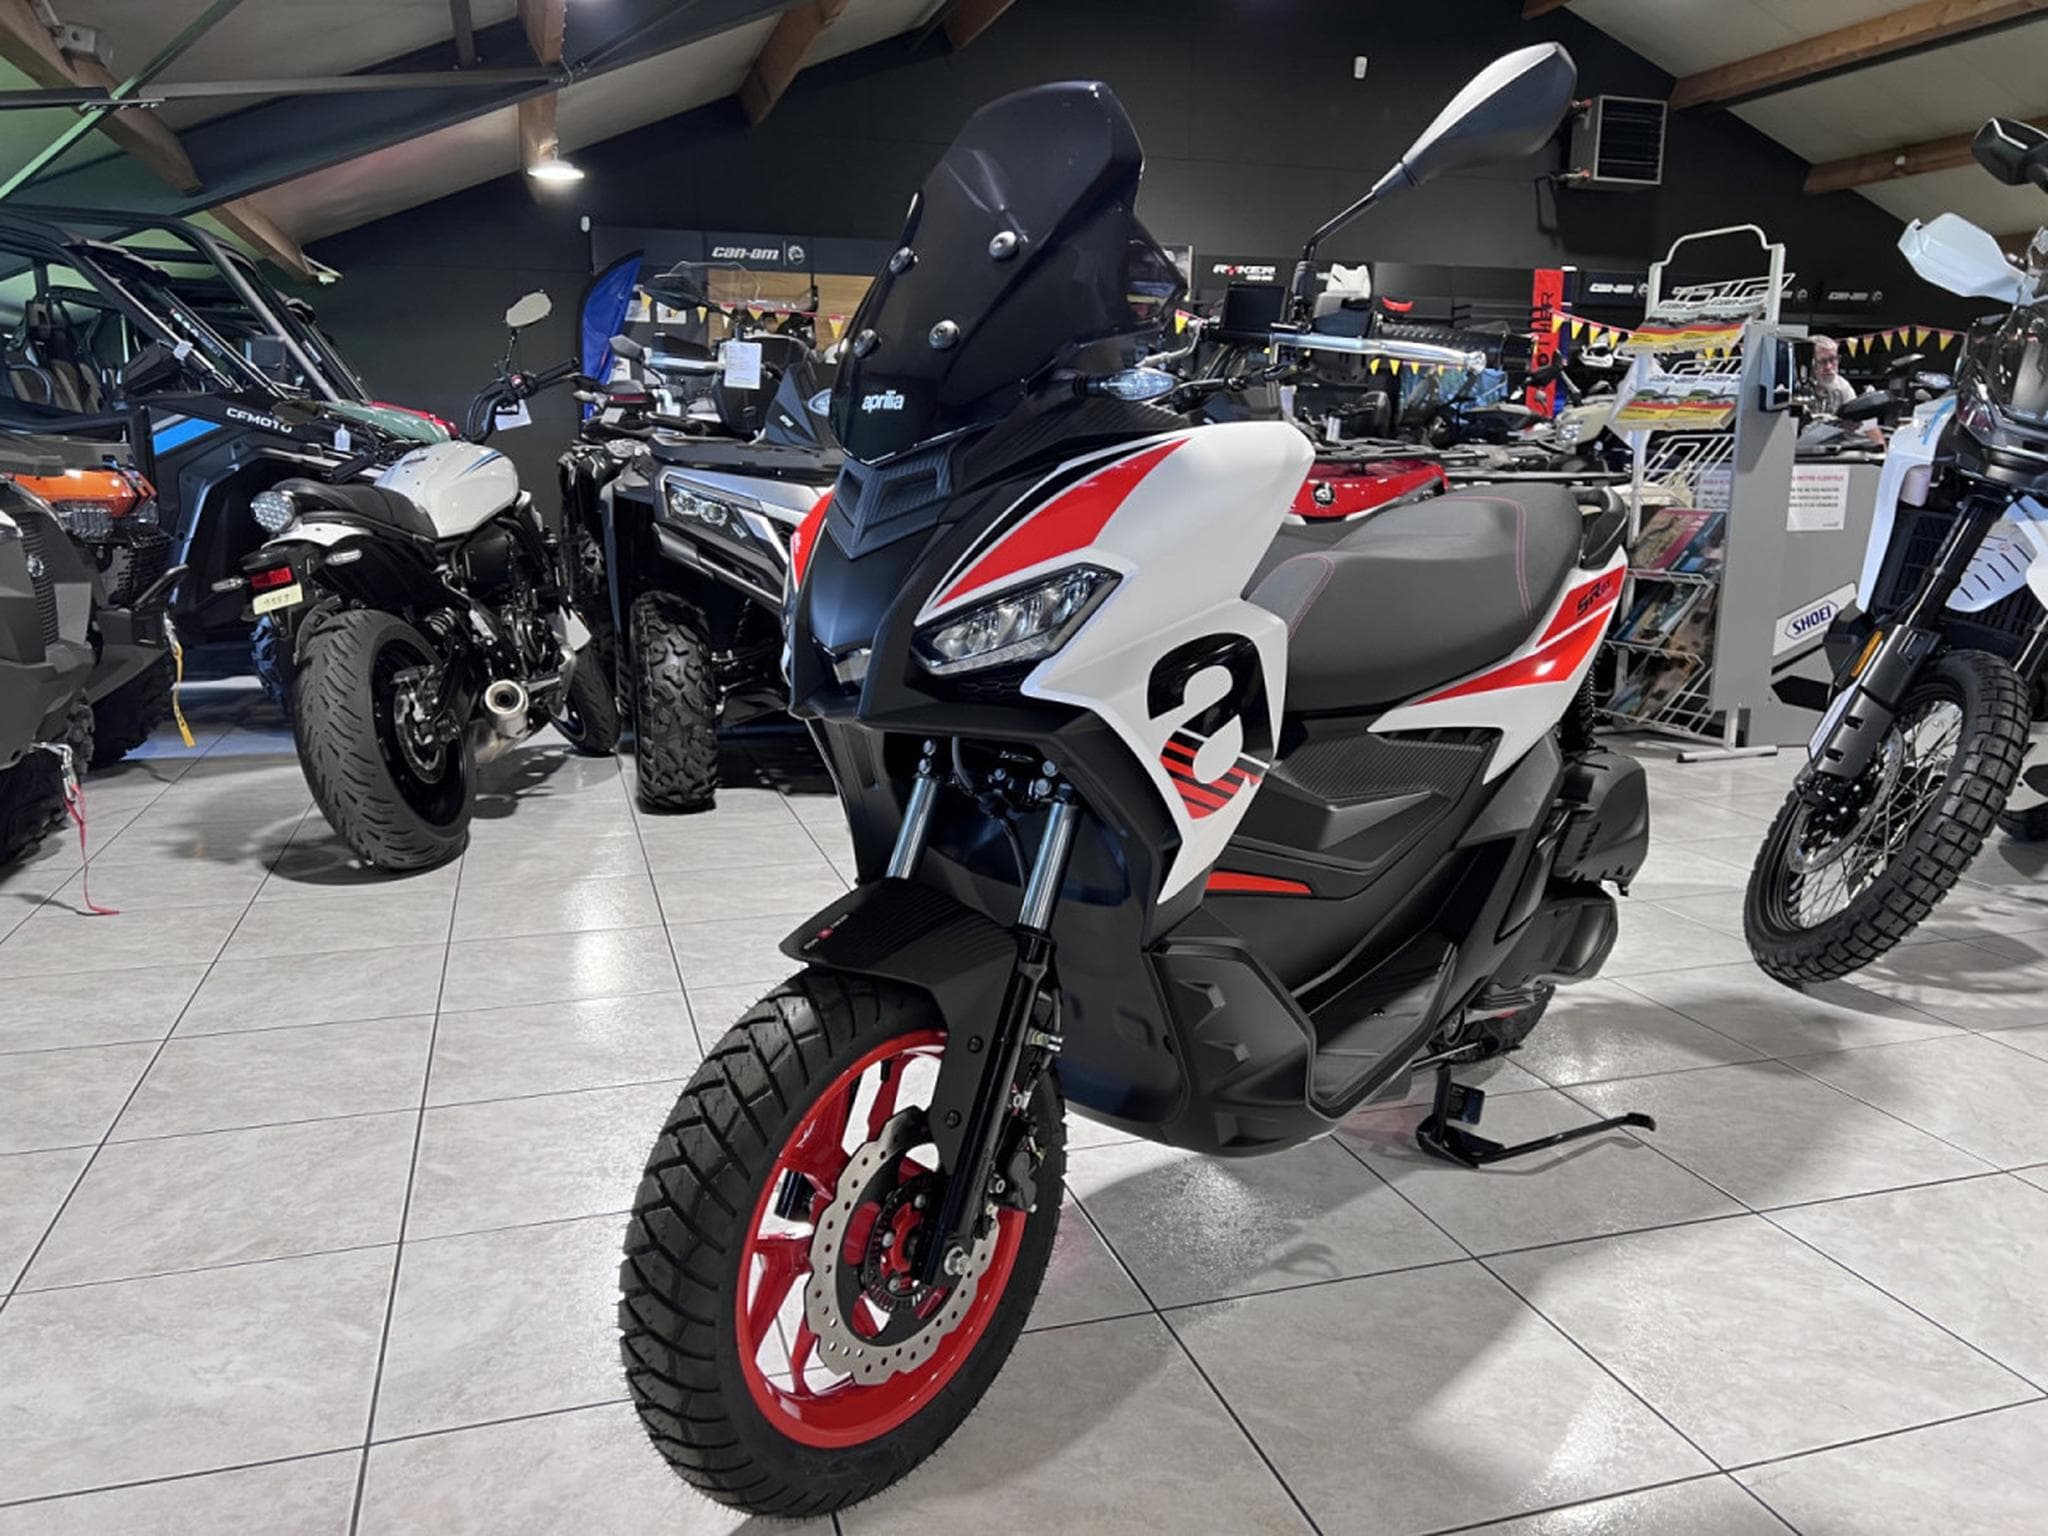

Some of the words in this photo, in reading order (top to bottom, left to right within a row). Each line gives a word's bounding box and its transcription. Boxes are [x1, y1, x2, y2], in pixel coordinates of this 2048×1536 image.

[711, 246, 779, 260] can-am
[861, 389, 905, 414] aprilia
[1792, 604, 1832, 635] SHOEI
